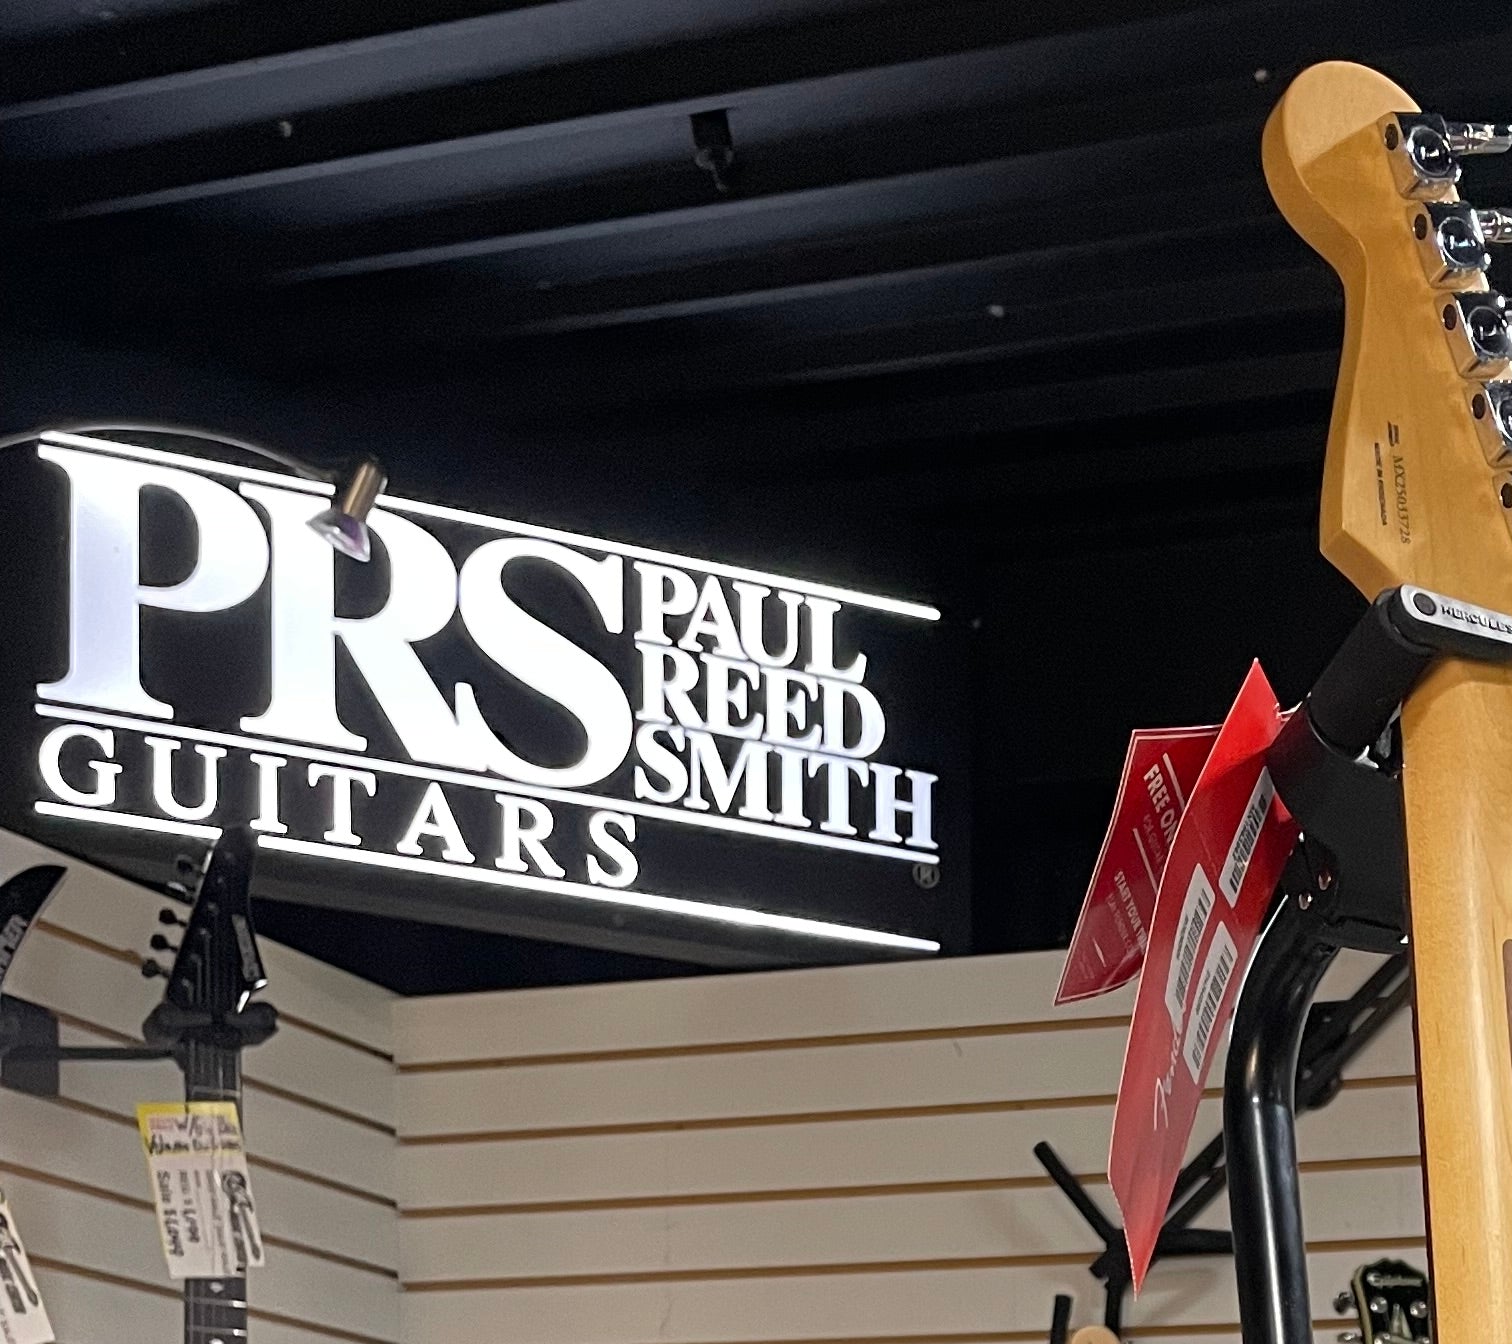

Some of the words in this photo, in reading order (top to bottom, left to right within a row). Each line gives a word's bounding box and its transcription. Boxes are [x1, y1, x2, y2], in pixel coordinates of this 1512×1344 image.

[36, 442, 634, 789] PRS
[634, 561, 868, 685] PAUL
[635, 641, 887, 760] REED
[36, 724, 640, 890] GUITARS
[634, 720, 938, 850] SMITH
[1143, 763, 1171, 813] FREE
